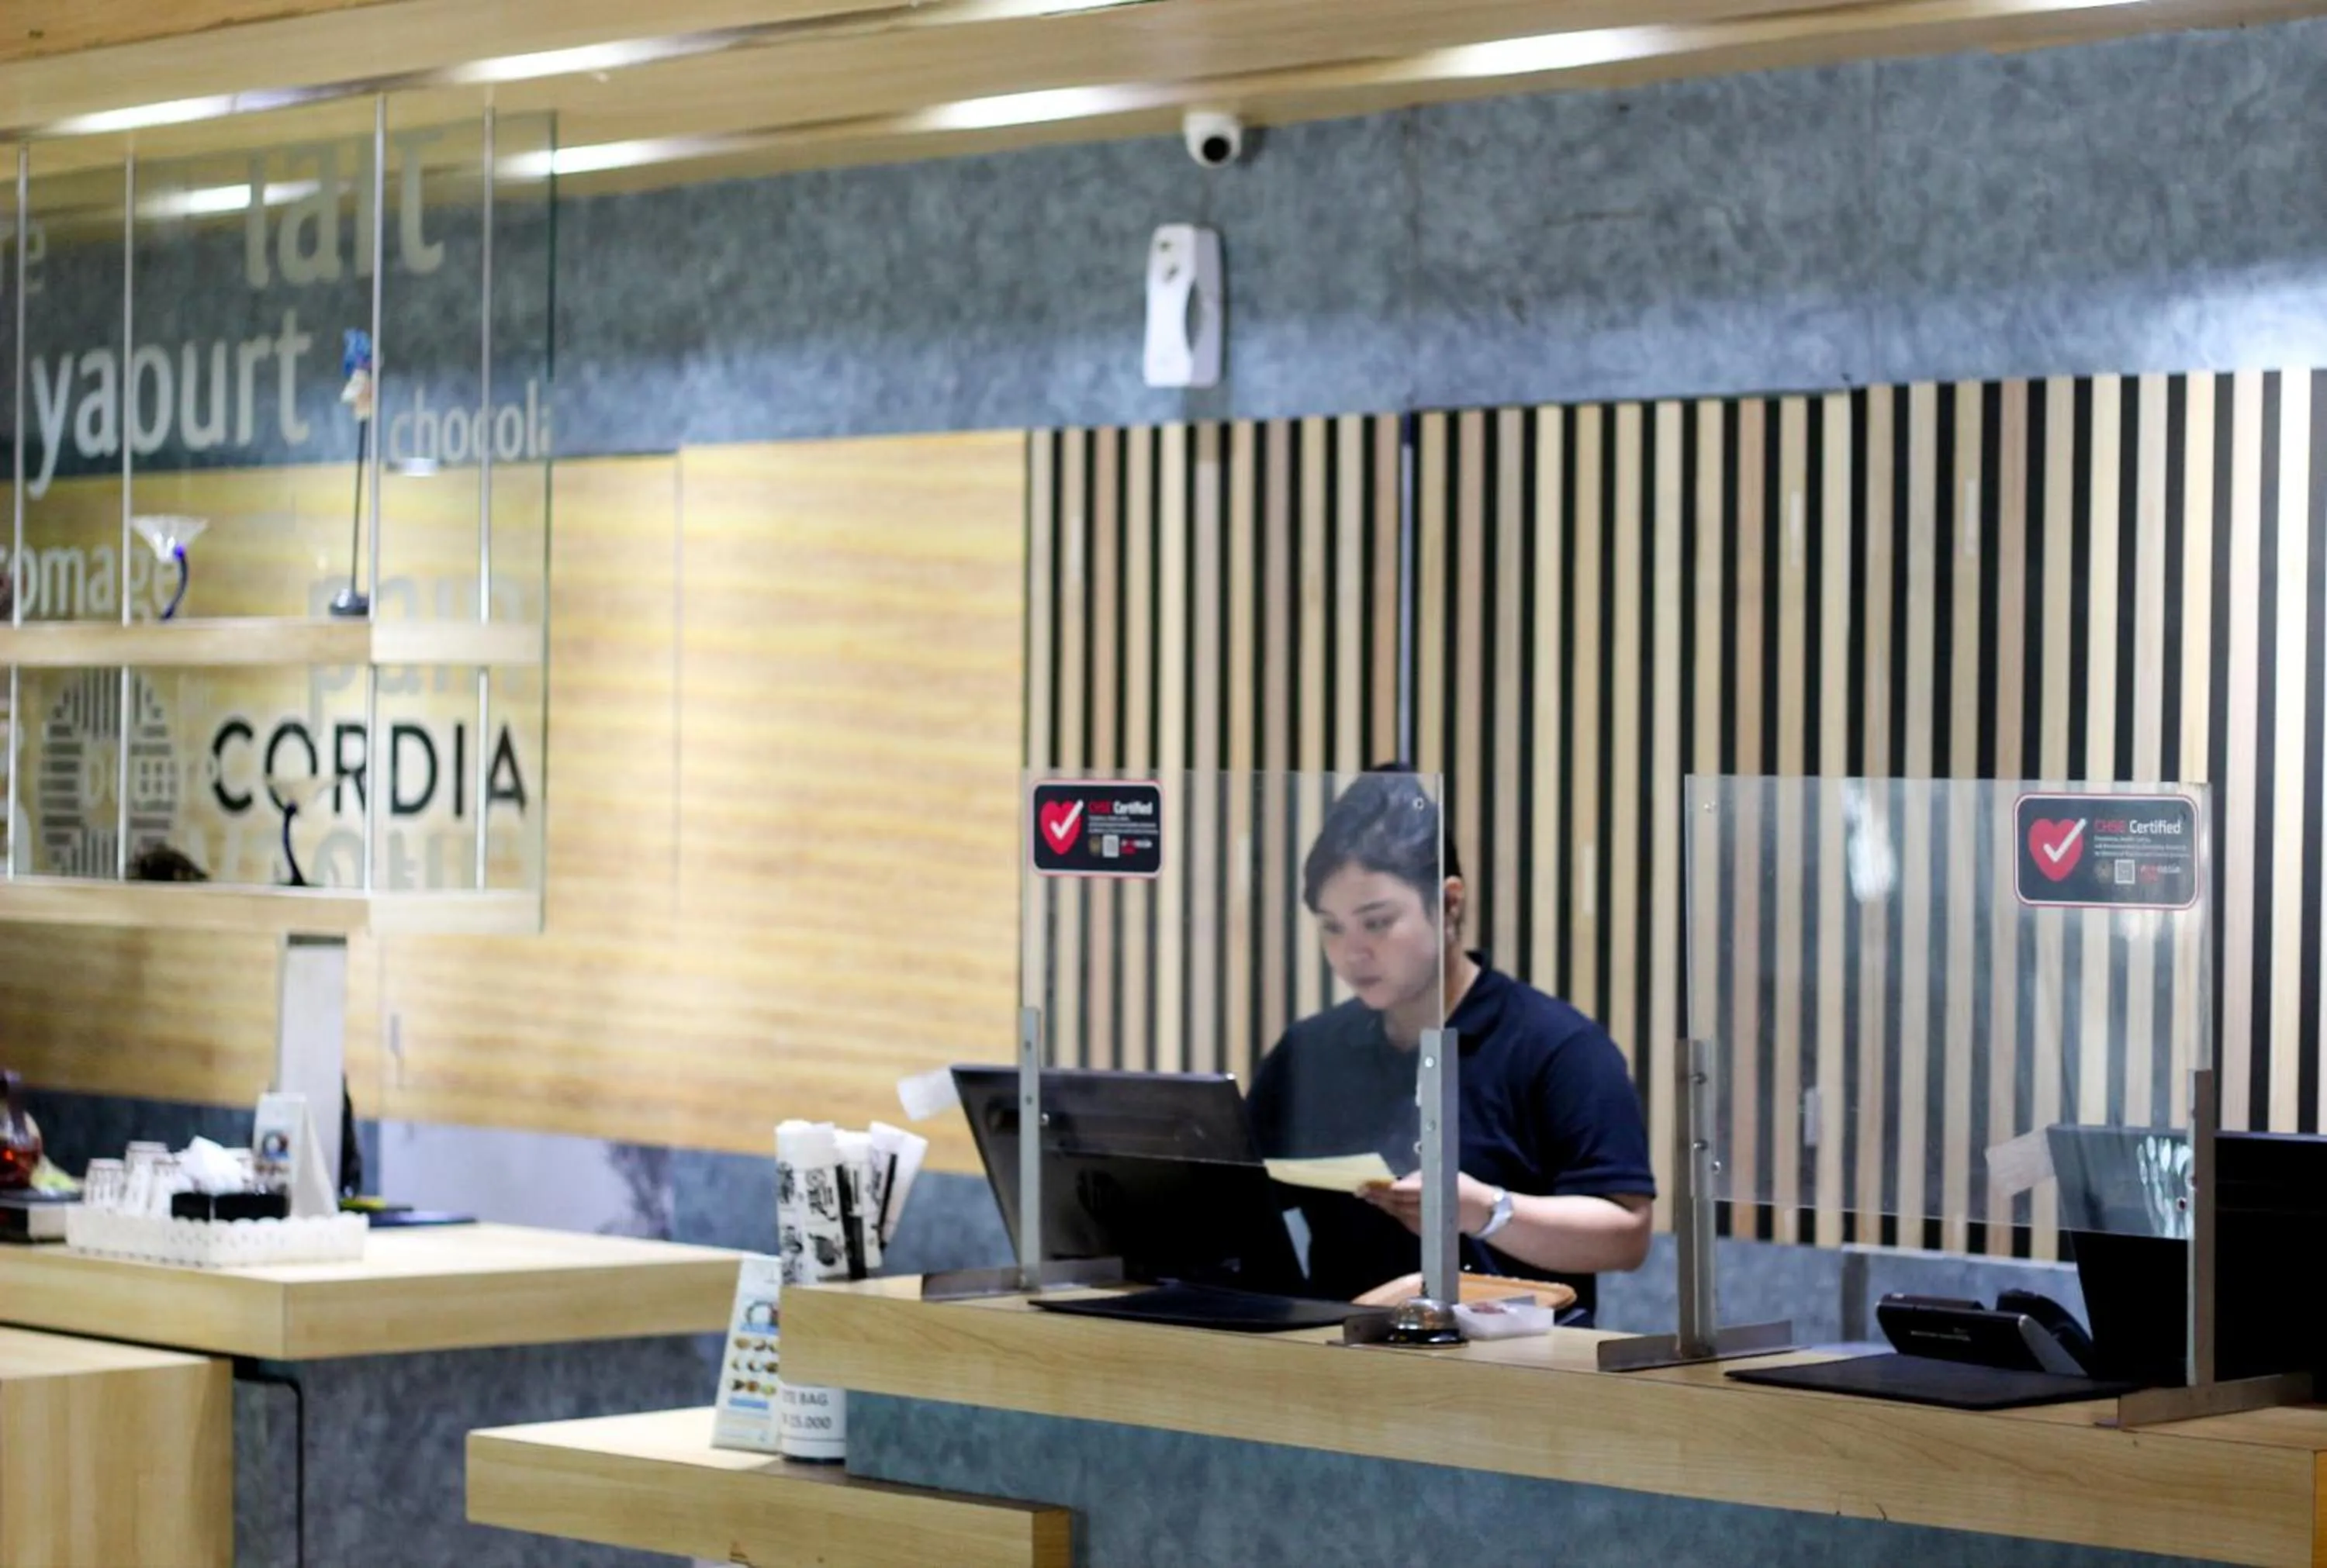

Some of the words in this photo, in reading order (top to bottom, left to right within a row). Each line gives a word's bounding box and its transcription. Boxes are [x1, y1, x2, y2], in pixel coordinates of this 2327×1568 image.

[28, 310, 313, 500] yaourt
[0, 543, 185, 622] omage
[211, 715, 529, 819] CORDIA
[2129, 818, 2181, 834] Certified
